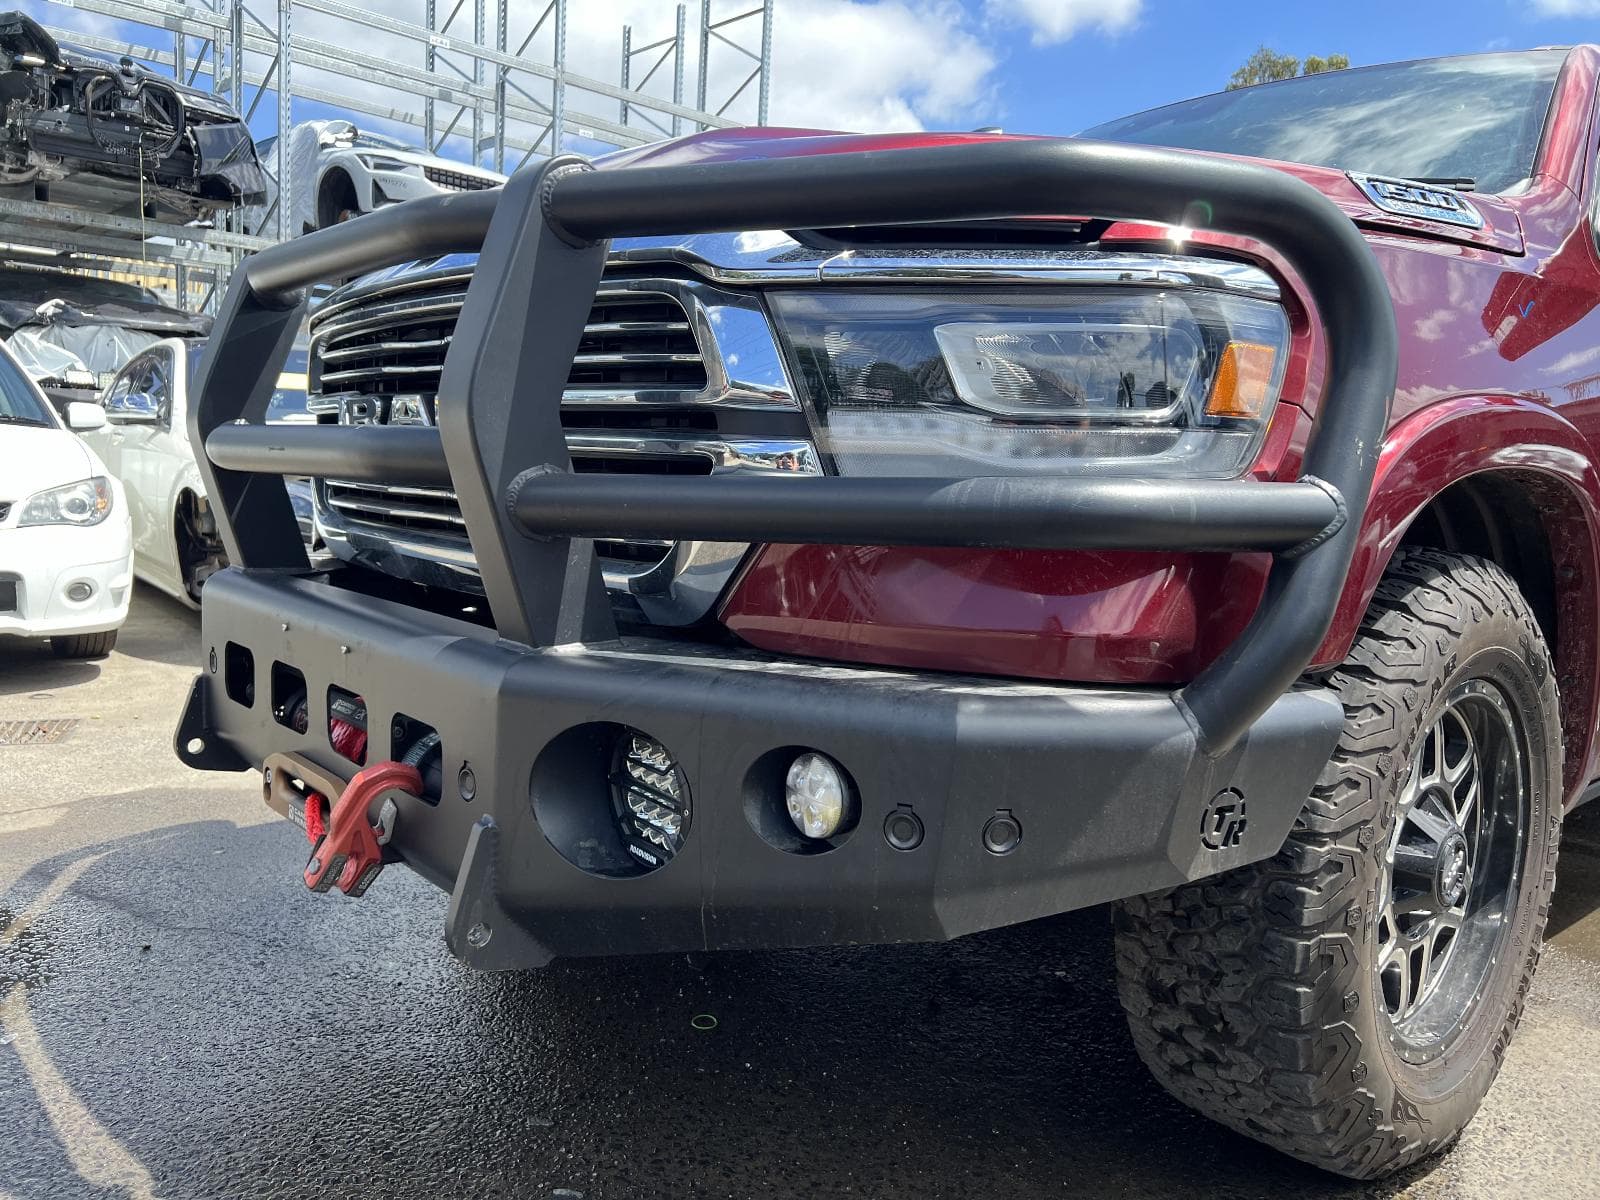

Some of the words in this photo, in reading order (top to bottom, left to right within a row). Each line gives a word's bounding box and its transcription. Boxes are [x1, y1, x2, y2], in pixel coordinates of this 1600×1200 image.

[338, 394, 440, 426] RA
[1543, 815, 1559, 891] ALL
[1492, 903, 1548, 1065] TERRAIN
